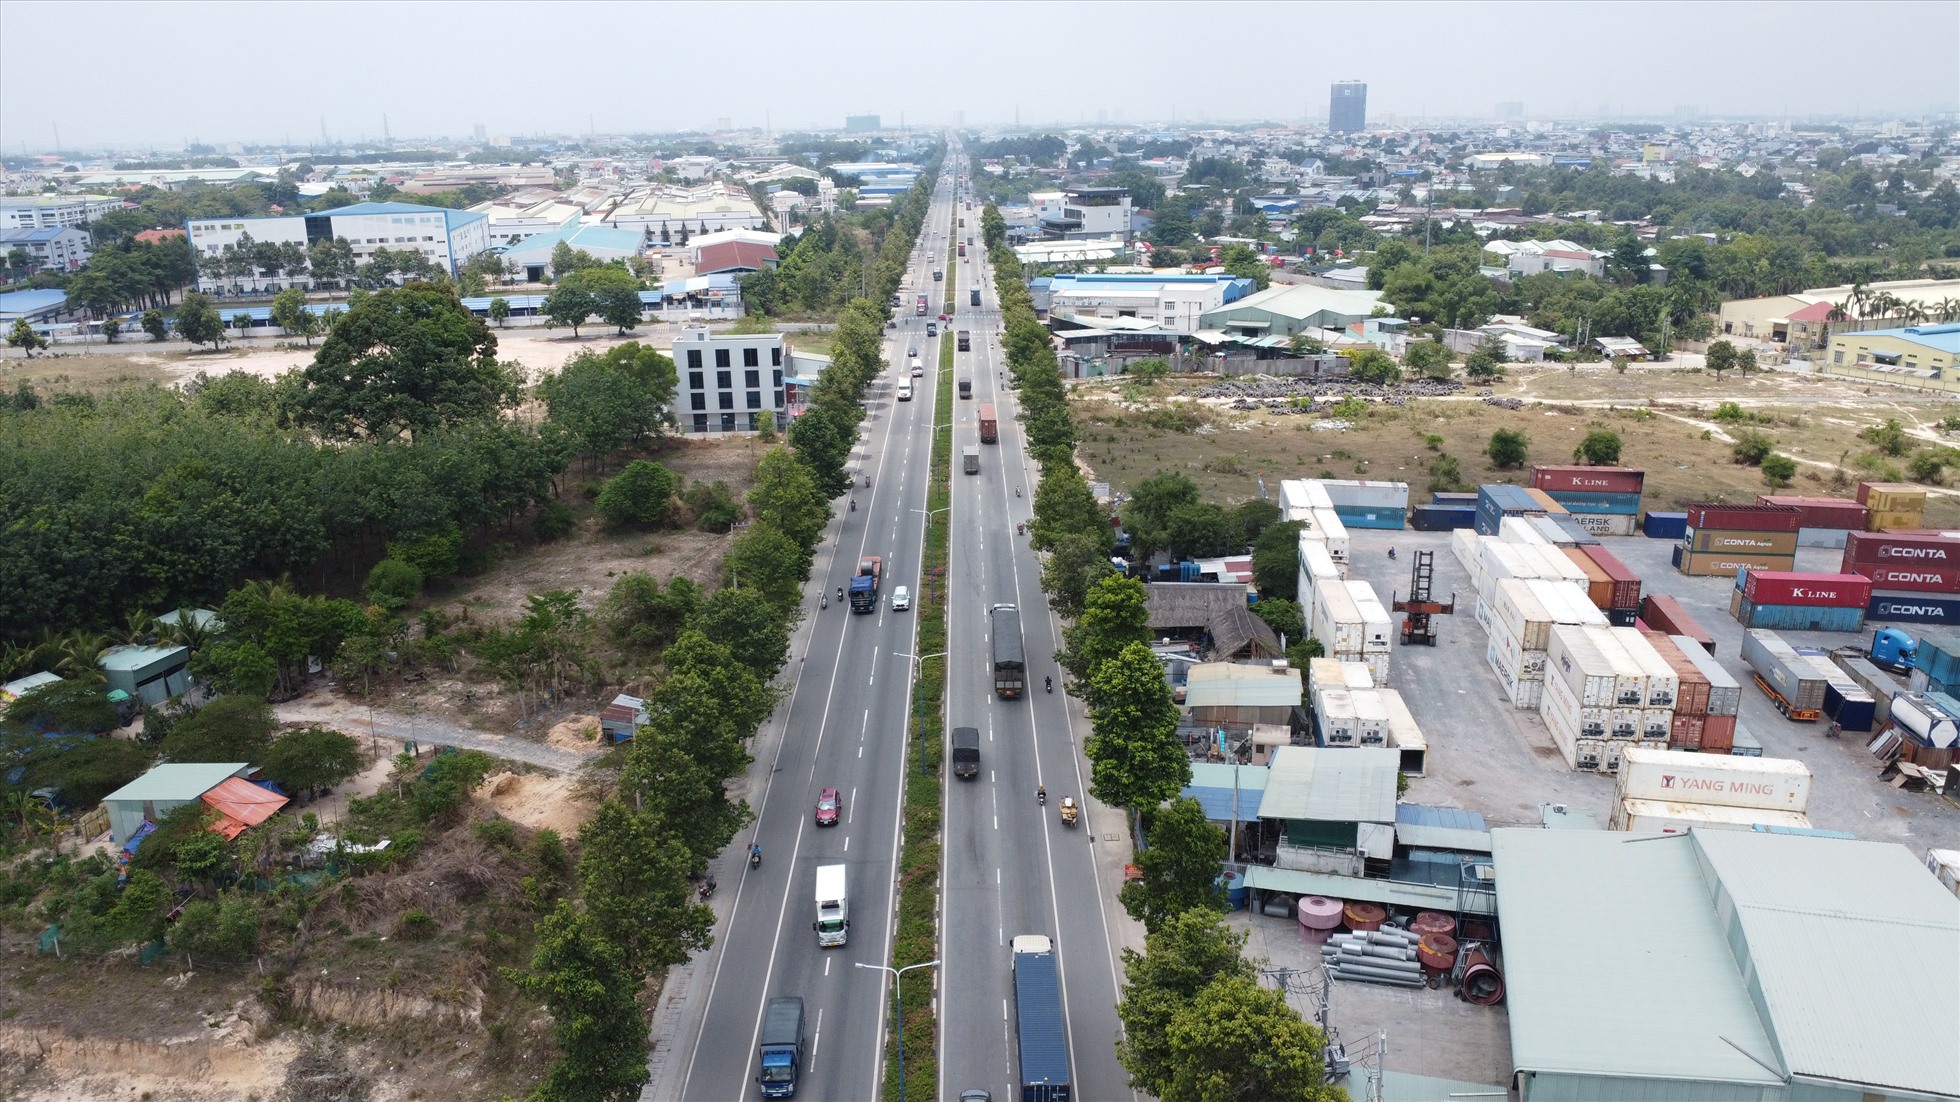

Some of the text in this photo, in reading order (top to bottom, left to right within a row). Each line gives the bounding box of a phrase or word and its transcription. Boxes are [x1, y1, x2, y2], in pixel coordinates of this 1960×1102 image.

[1572, 477, 1582, 485] K
[1574, 518, 1611, 526] AERSK
[1891, 547, 1947, 559] CONTA
[1720, 562, 1752, 570] CONTA
[1887, 572, 1943, 584] CONTA
[1792, 588, 1837, 599] K LINE
[1890, 605, 1945, 617] CONTA
[1494, 653, 1514, 691] MAERSK
[1680, 777, 1725, 792] YANG
[1729, 781, 1774, 796] MING
